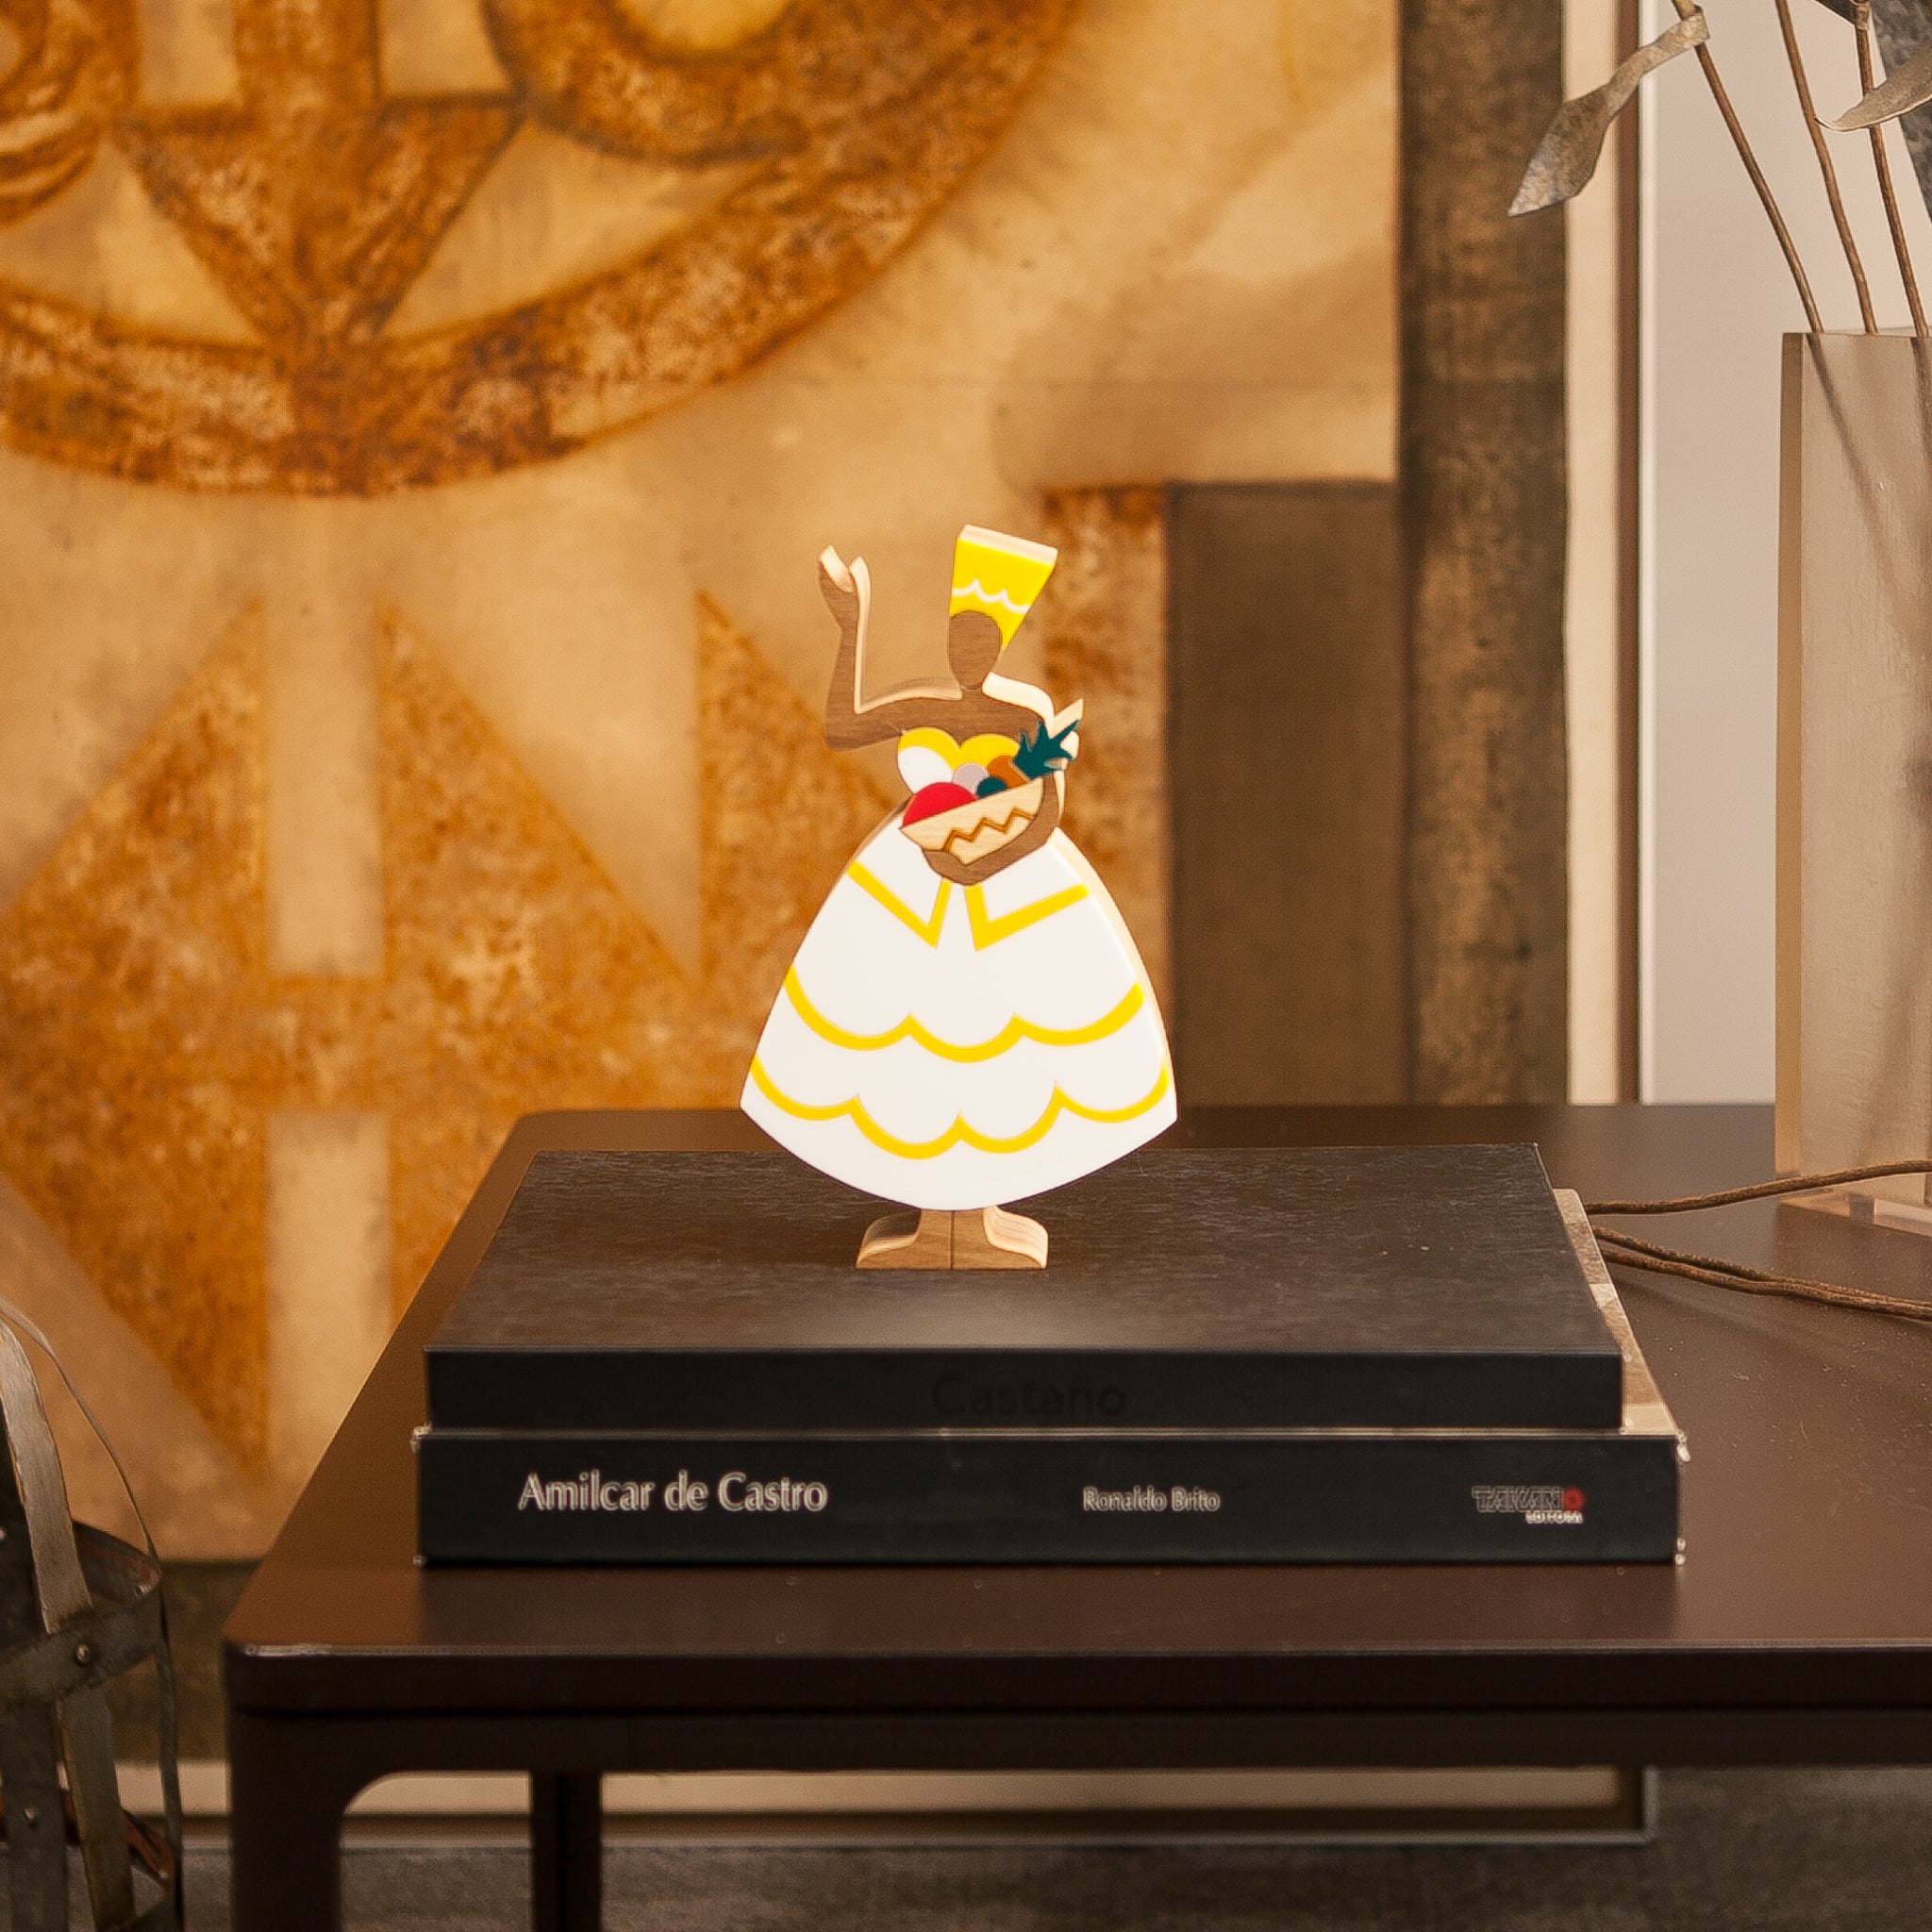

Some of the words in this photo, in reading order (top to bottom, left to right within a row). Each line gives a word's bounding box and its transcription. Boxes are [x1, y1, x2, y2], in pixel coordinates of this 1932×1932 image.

[518, 1469, 656, 1511] Amilcar
[664, 1469, 709, 1511] de
[718, 1472, 828, 1512] Castro
[1083, 1485, 1167, 1511] Ronaldo
[1172, 1485, 1221, 1511] Brito
